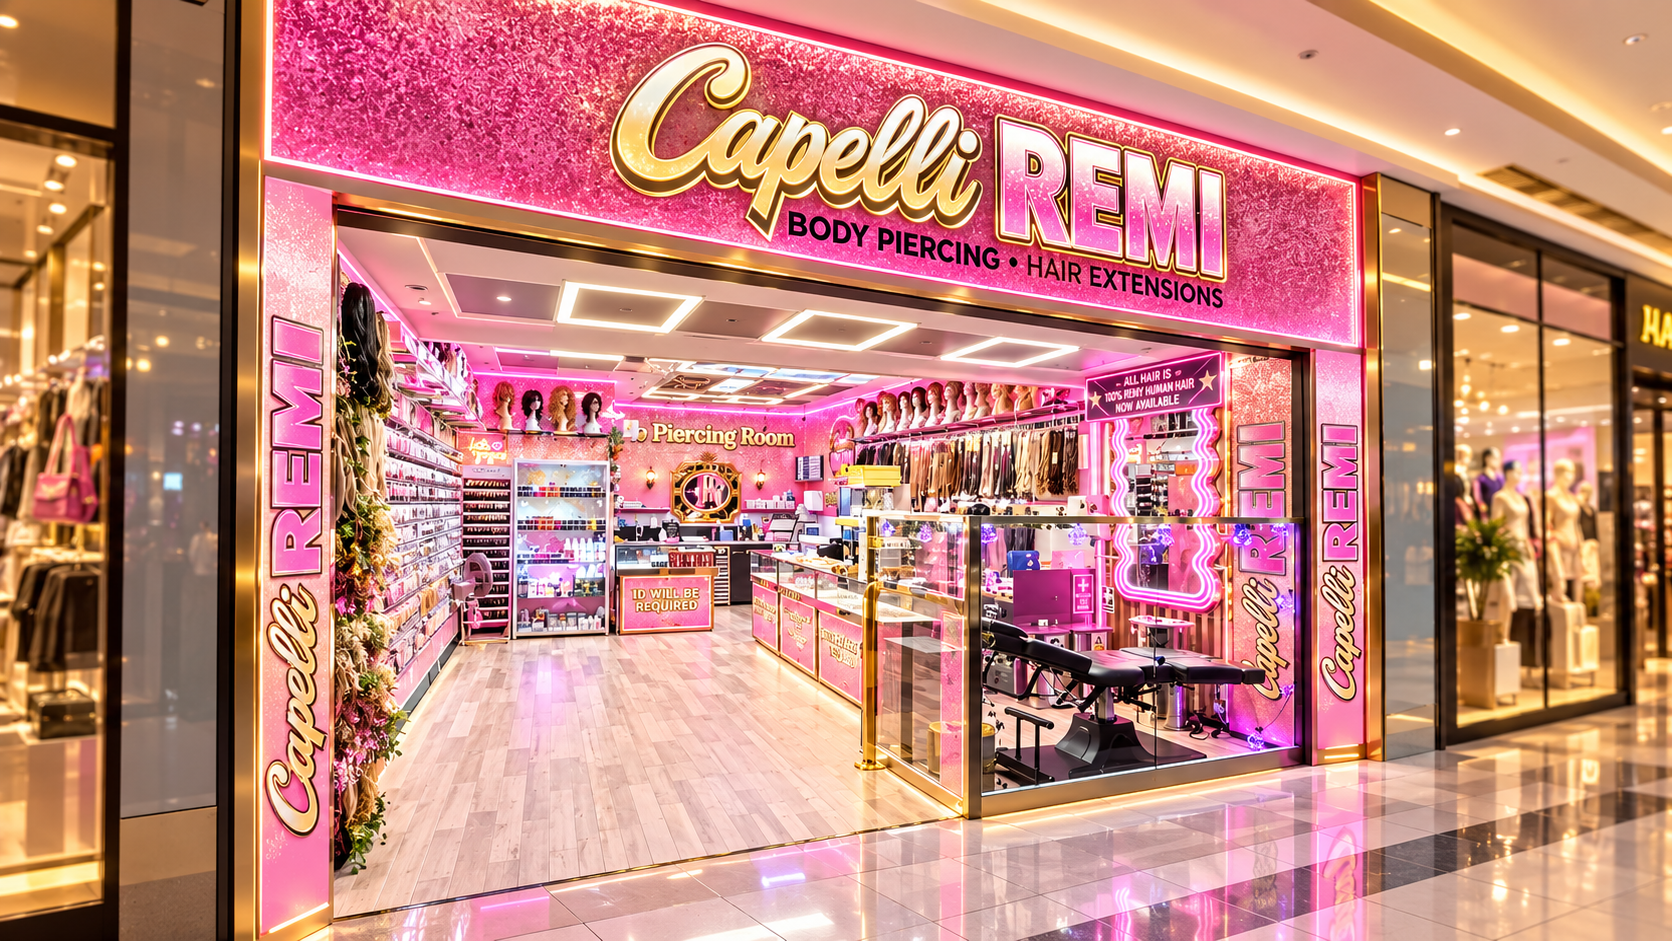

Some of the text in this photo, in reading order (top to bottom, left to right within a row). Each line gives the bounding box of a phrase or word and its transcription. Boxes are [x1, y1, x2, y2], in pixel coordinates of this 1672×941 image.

[610, 43, 1228, 283] Capelli REMI
[787, 210, 1224, 309] BODY PIERCING HAIR EXTENSIONS
[1123, 368, 1172, 387] ALL HAIR IS
[1115, 393, 1180, 414] NOW AVAILABLE
[651, 422, 737, 451] Piercing
[740, 426, 796, 447] Room
[265, 315, 327, 837] Capelli REMI
[1320, 423, 1362, 701] Capelli REMI
[632, 586, 700, 600] ID WILL BE
[635, 599, 699, 614] REQUIRED
